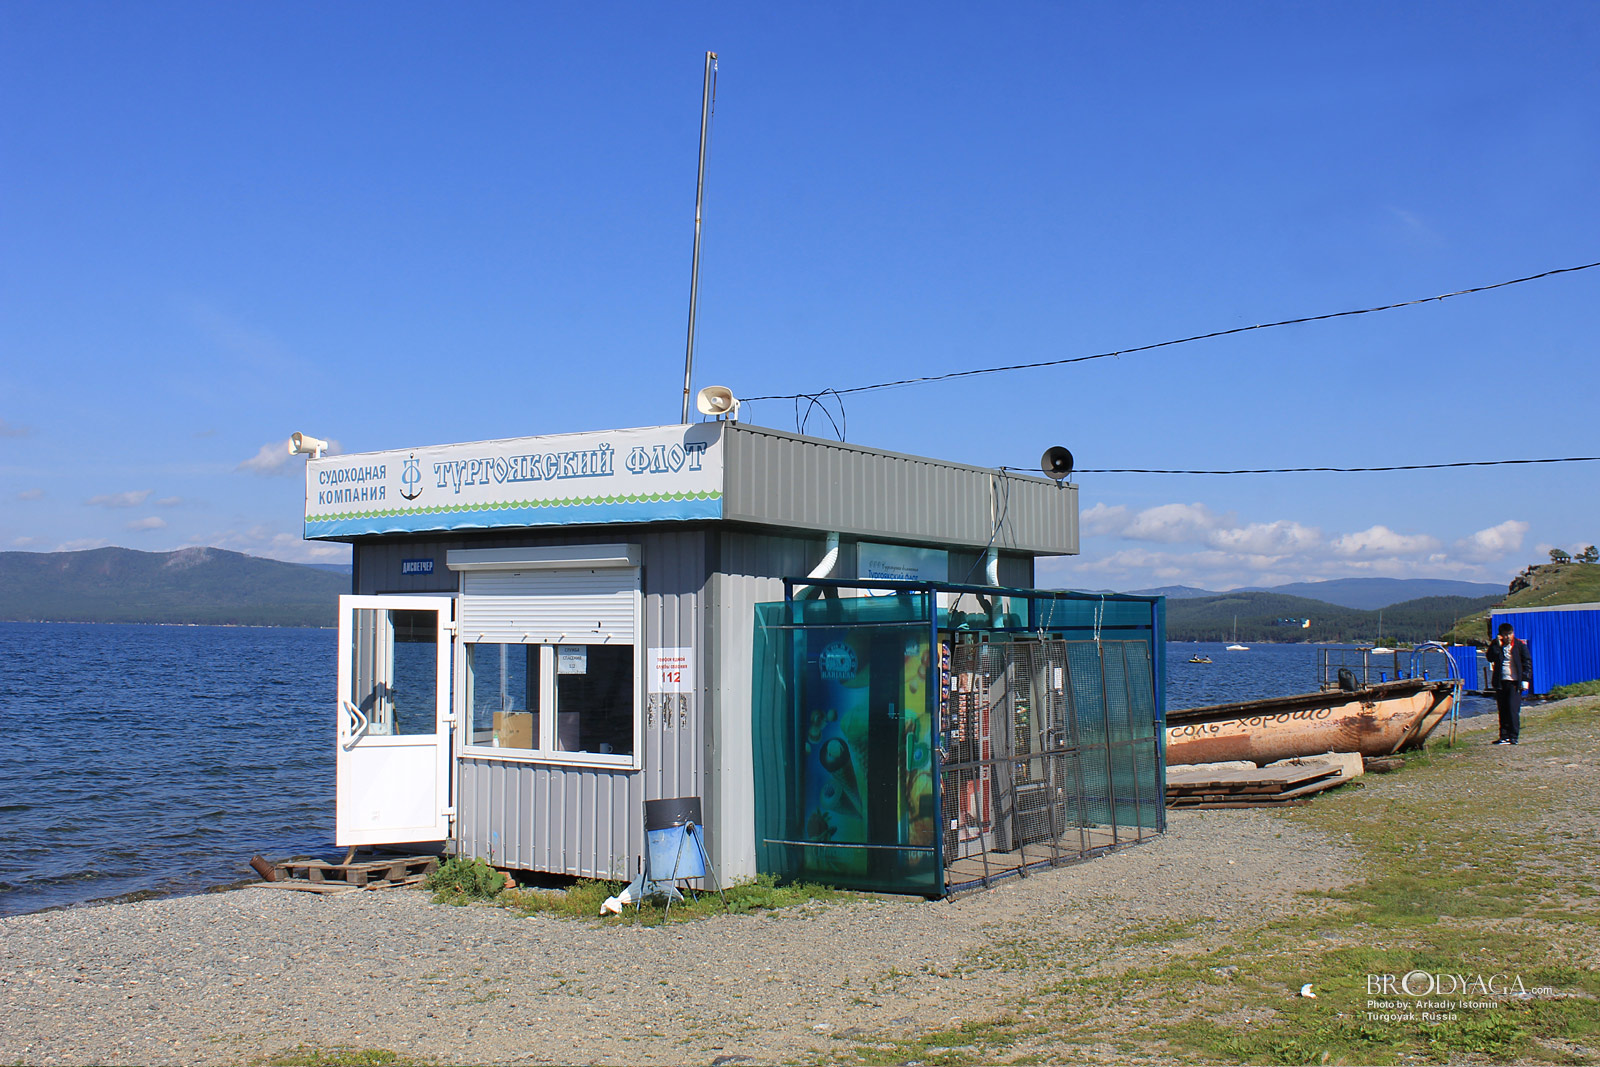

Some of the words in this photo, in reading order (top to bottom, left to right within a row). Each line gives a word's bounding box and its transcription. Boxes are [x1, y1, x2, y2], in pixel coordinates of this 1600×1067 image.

[319, 464, 387, 486] СУДОХОДНАЯ
[434, 443, 615, 494] ТУРГОЯКСКИЙ
[625, 442, 708, 474] ФЛОТ
[318, 485, 387, 505] КОМПАНИЯ
[662, 671, 681, 683] 112
